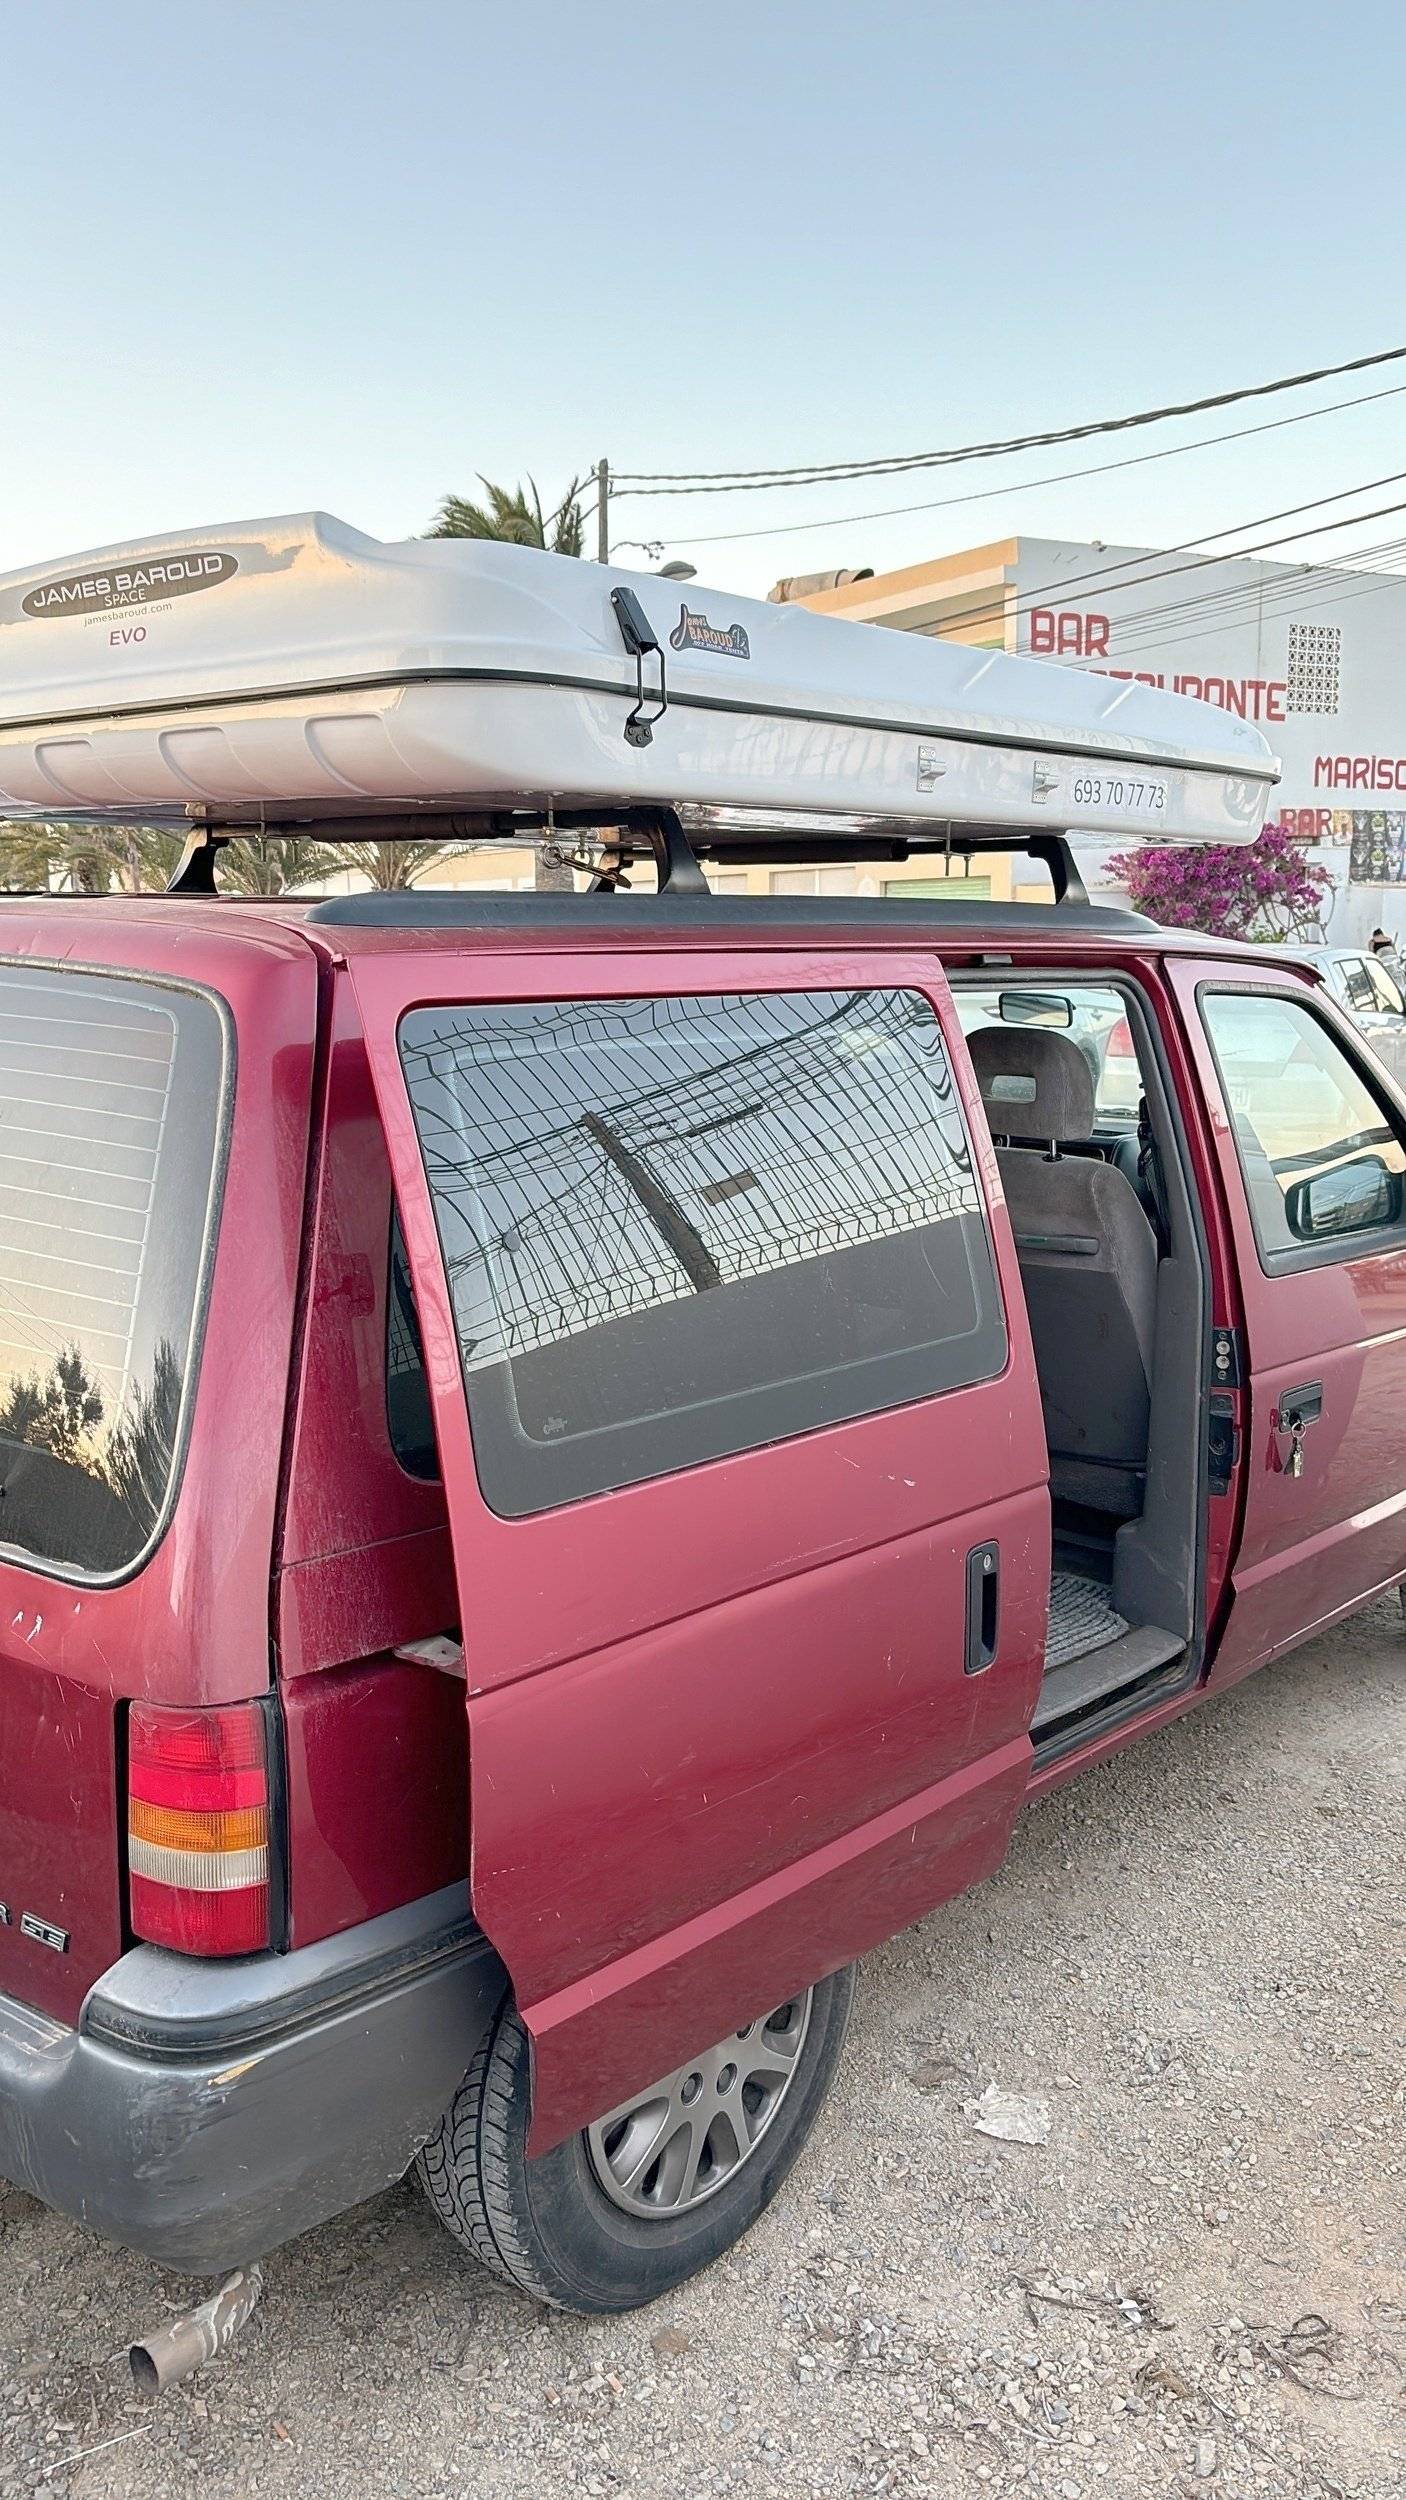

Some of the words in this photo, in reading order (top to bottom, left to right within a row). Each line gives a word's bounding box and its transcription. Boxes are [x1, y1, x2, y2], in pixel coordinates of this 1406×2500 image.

[33, 577, 111, 608] JAMES
[115, 555, 223, 592] BAROUD
[104, 588, 147, 607] SPACE
[84, 601, 173, 627] jamesbaroud.com
[109, 626, 147, 646] EVO
[1031, 608, 1109, 657] BAR
[1074, 779, 1102, 804] 693
[1106, 781, 1124, 805] 70
[1128, 783, 1144, 806] 77
[1148, 785, 1164, 809] 73
[1280, 808, 1332, 838] BAR
[20, 1912, 69, 1952] SE
